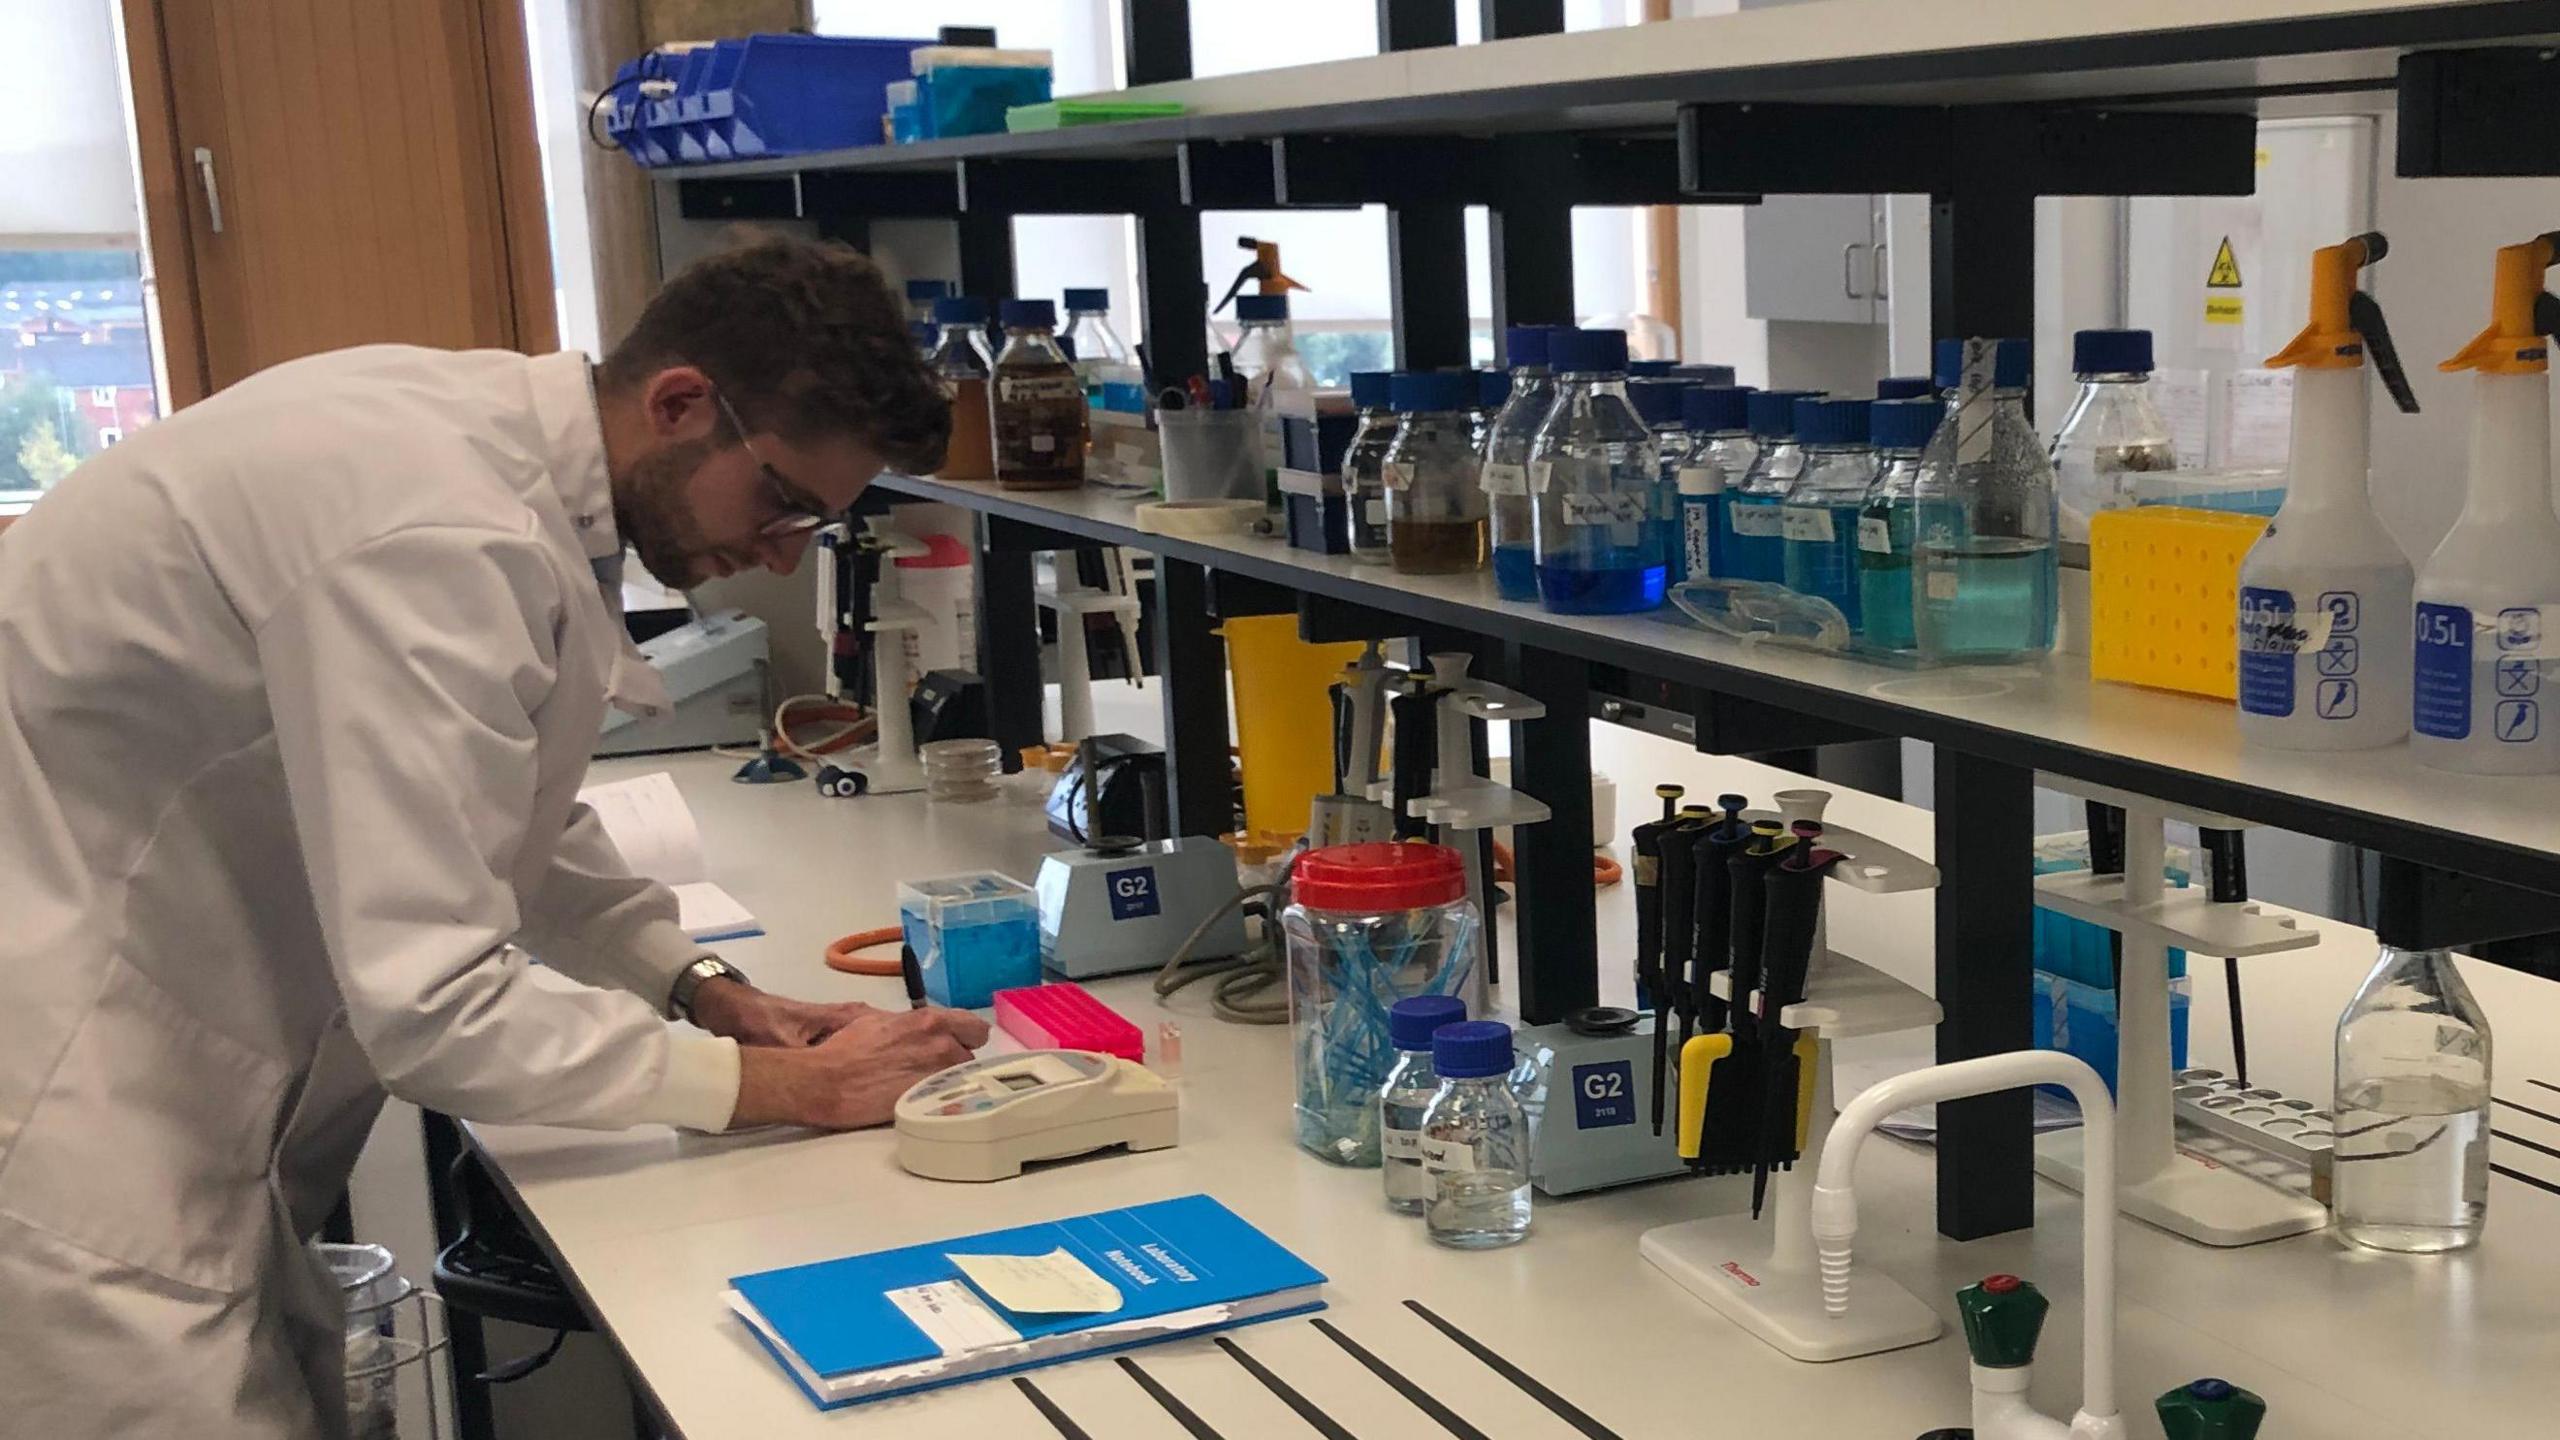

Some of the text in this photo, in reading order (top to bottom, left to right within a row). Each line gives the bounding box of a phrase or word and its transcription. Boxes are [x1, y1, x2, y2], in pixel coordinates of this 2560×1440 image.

[2418, 612, 2465, 647] 0.5L
[1116, 876, 1149, 897] G2
[1584, 1072, 1623, 1099] G2
[1104, 1250, 1159, 1285] Notebook
[1140, 1243, 1199, 1282] Laboratory
